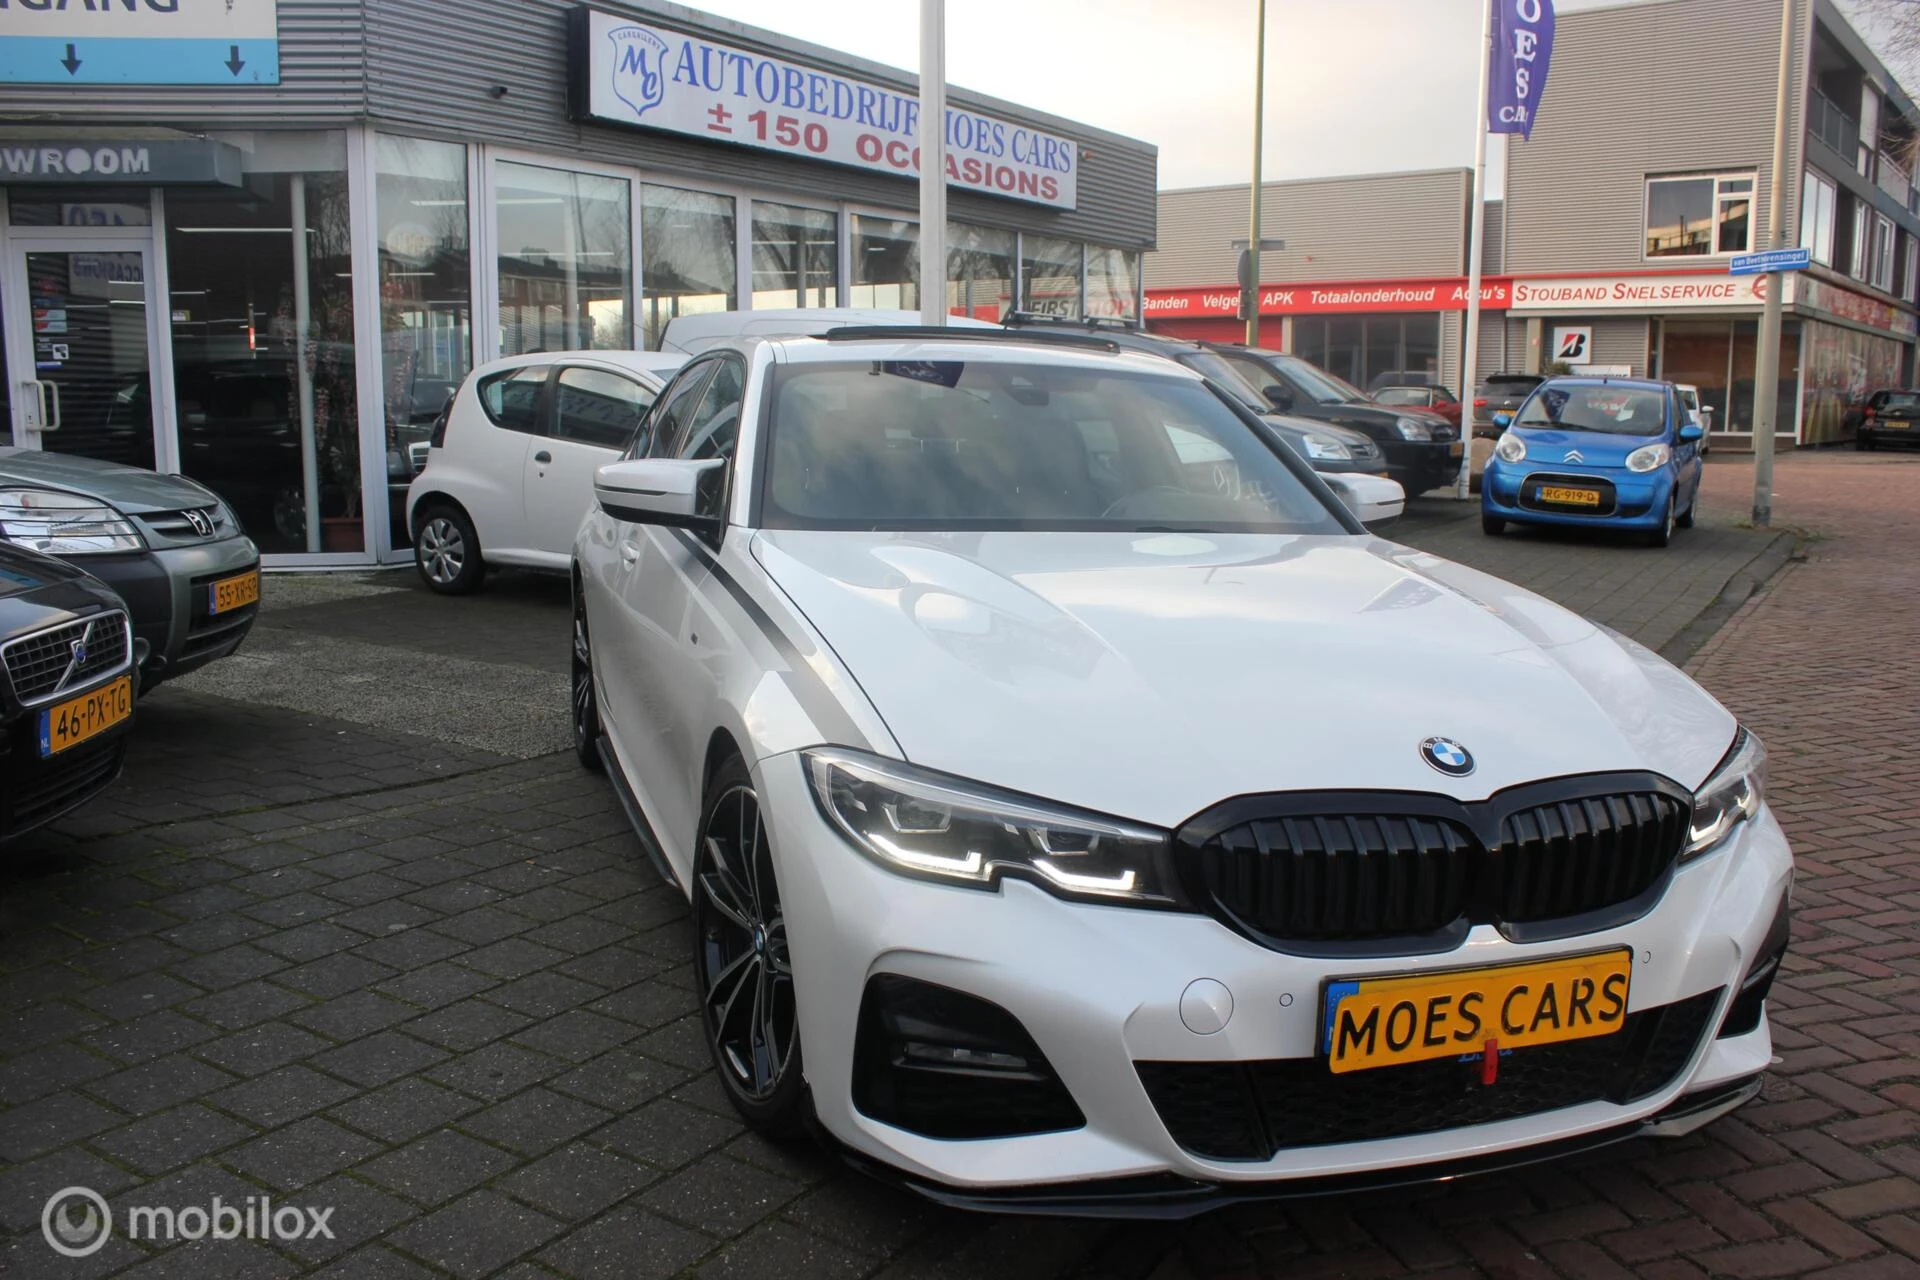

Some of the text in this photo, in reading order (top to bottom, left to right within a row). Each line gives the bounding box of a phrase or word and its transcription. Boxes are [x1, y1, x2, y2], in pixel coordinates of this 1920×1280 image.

[672, 41, 1072, 174] AUTOBEDRIJF OES CARS
[748, 110, 829, 153] 150
[0, 147, 150, 175] WROOM
[1143, 297, 1189, 310] Banden
[1202, 294, 1238, 310] Velge
[1262, 291, 1295, 306] APK
[1311, 288, 1436, 304] Totaalonderhoud
[1515, 282, 1736, 301] STOUBAND SNELSERVICE
[57, 683, 126, 742] 46-PX-TG
[1336, 973, 1627, 1061] MOES CARS
